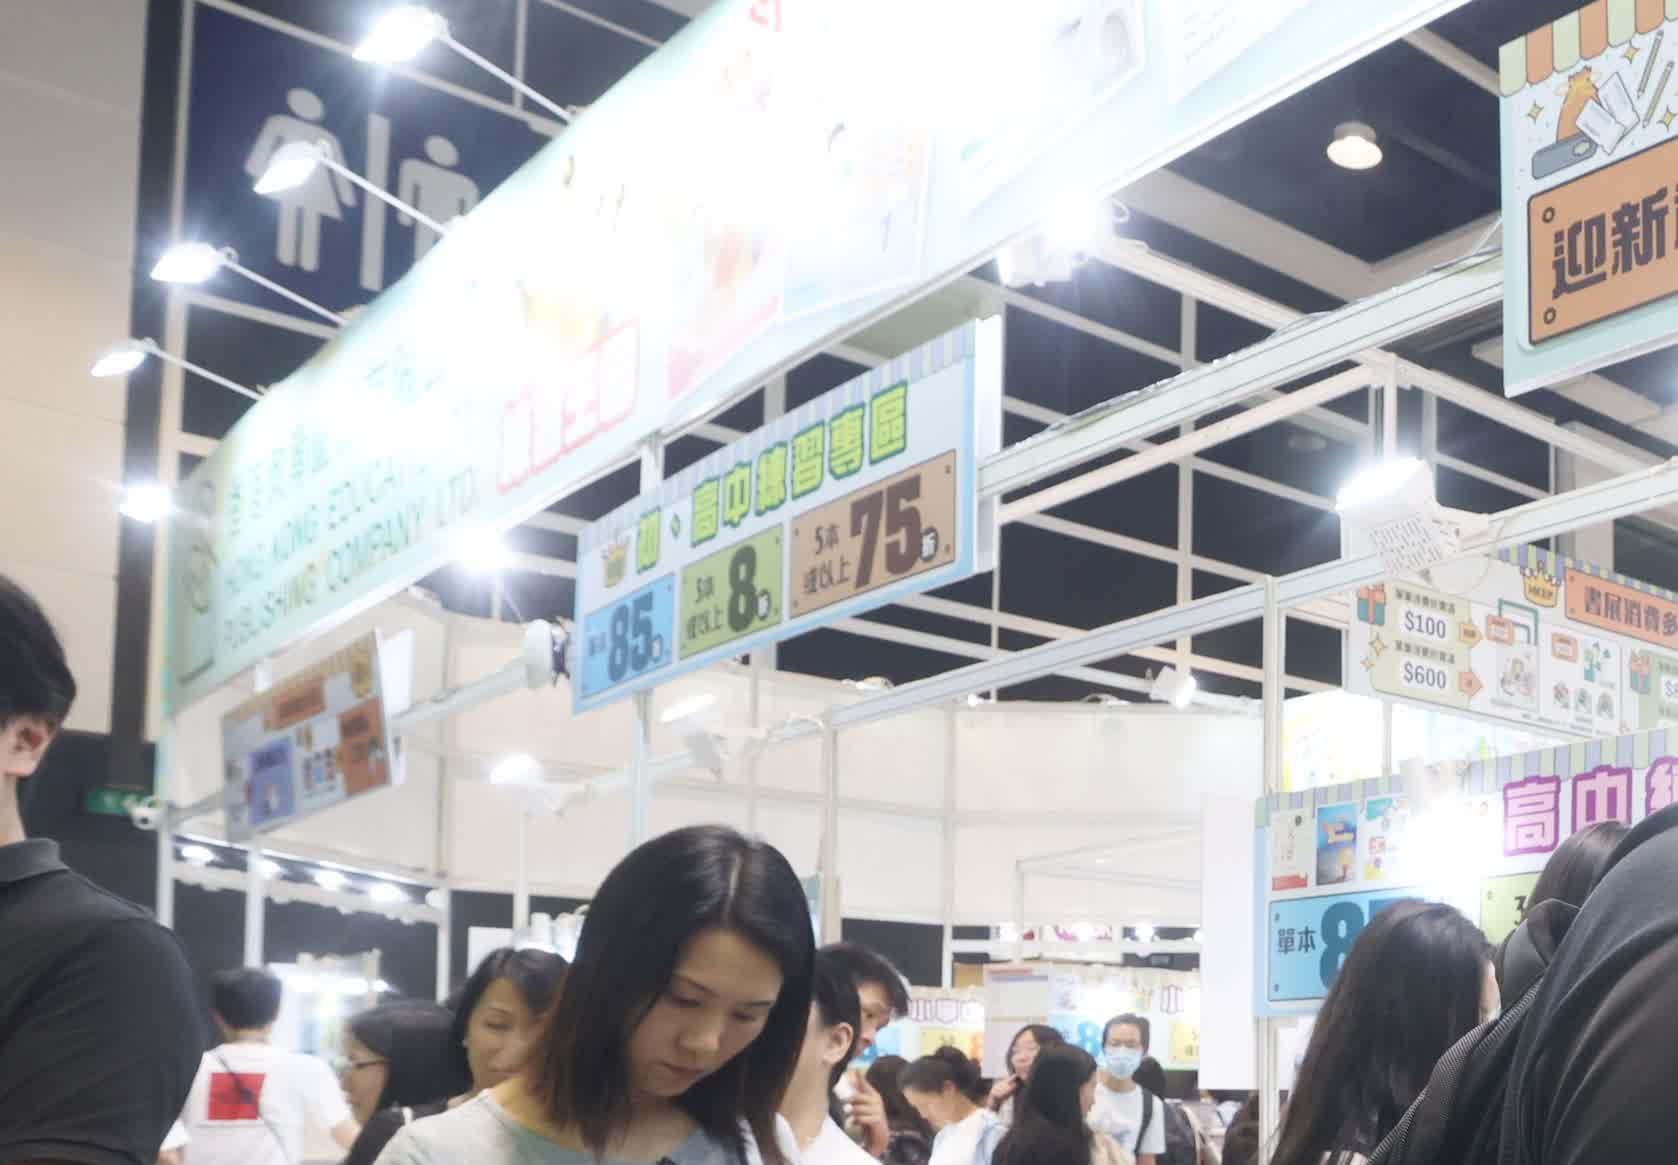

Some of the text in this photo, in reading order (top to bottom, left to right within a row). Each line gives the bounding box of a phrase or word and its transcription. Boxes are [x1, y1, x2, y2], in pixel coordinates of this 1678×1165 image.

[1404, 610, 1447, 639] $100
[1403, 661, 1447, 690] $600
[1277, 925, 1316, 953] 單本
